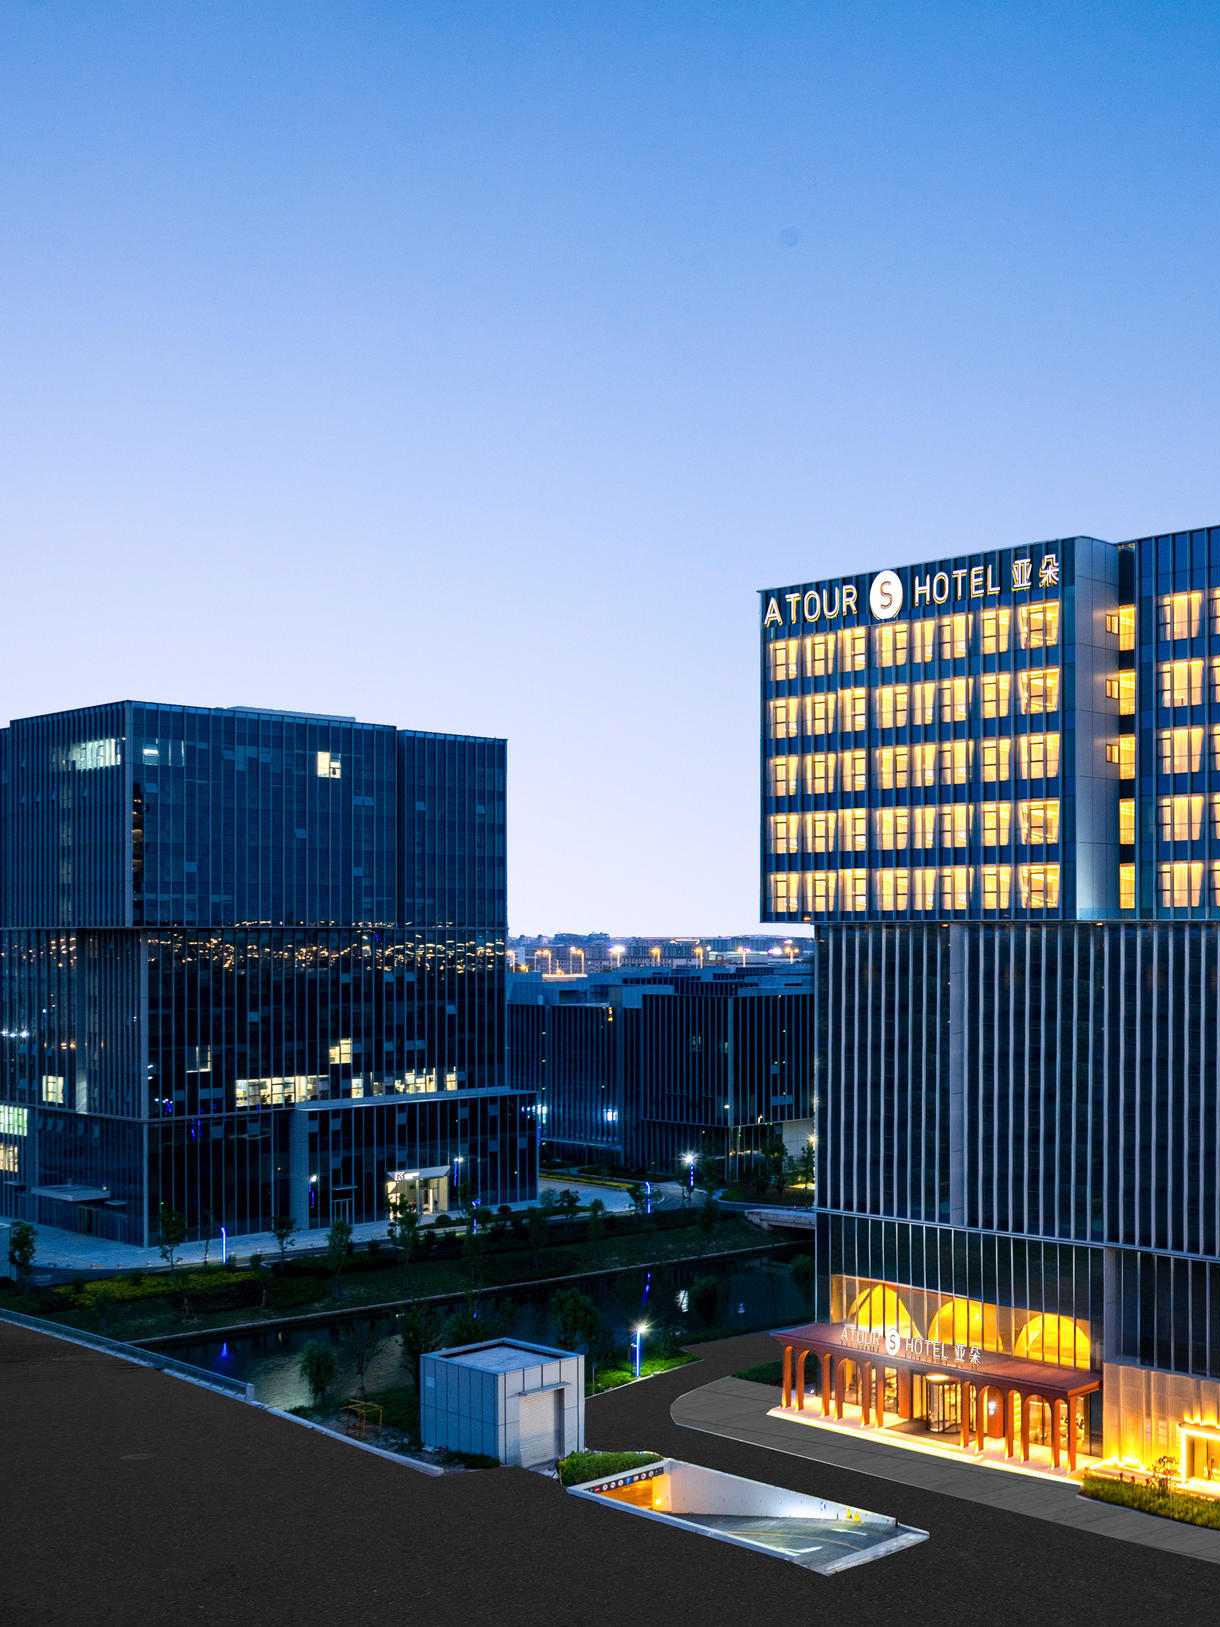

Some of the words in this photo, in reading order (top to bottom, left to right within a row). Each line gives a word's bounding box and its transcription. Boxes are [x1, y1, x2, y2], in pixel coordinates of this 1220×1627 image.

[764, 585, 858, 626] ATOUR
[914, 564, 1001, 606] HOTEL
[1011, 553, 1060, 591] 亚朵
[840, 1327, 880, 1346] ATOUR
[905, 1338, 949, 1359] HOTEL
[955, 1343, 981, 1365] 亚朵
